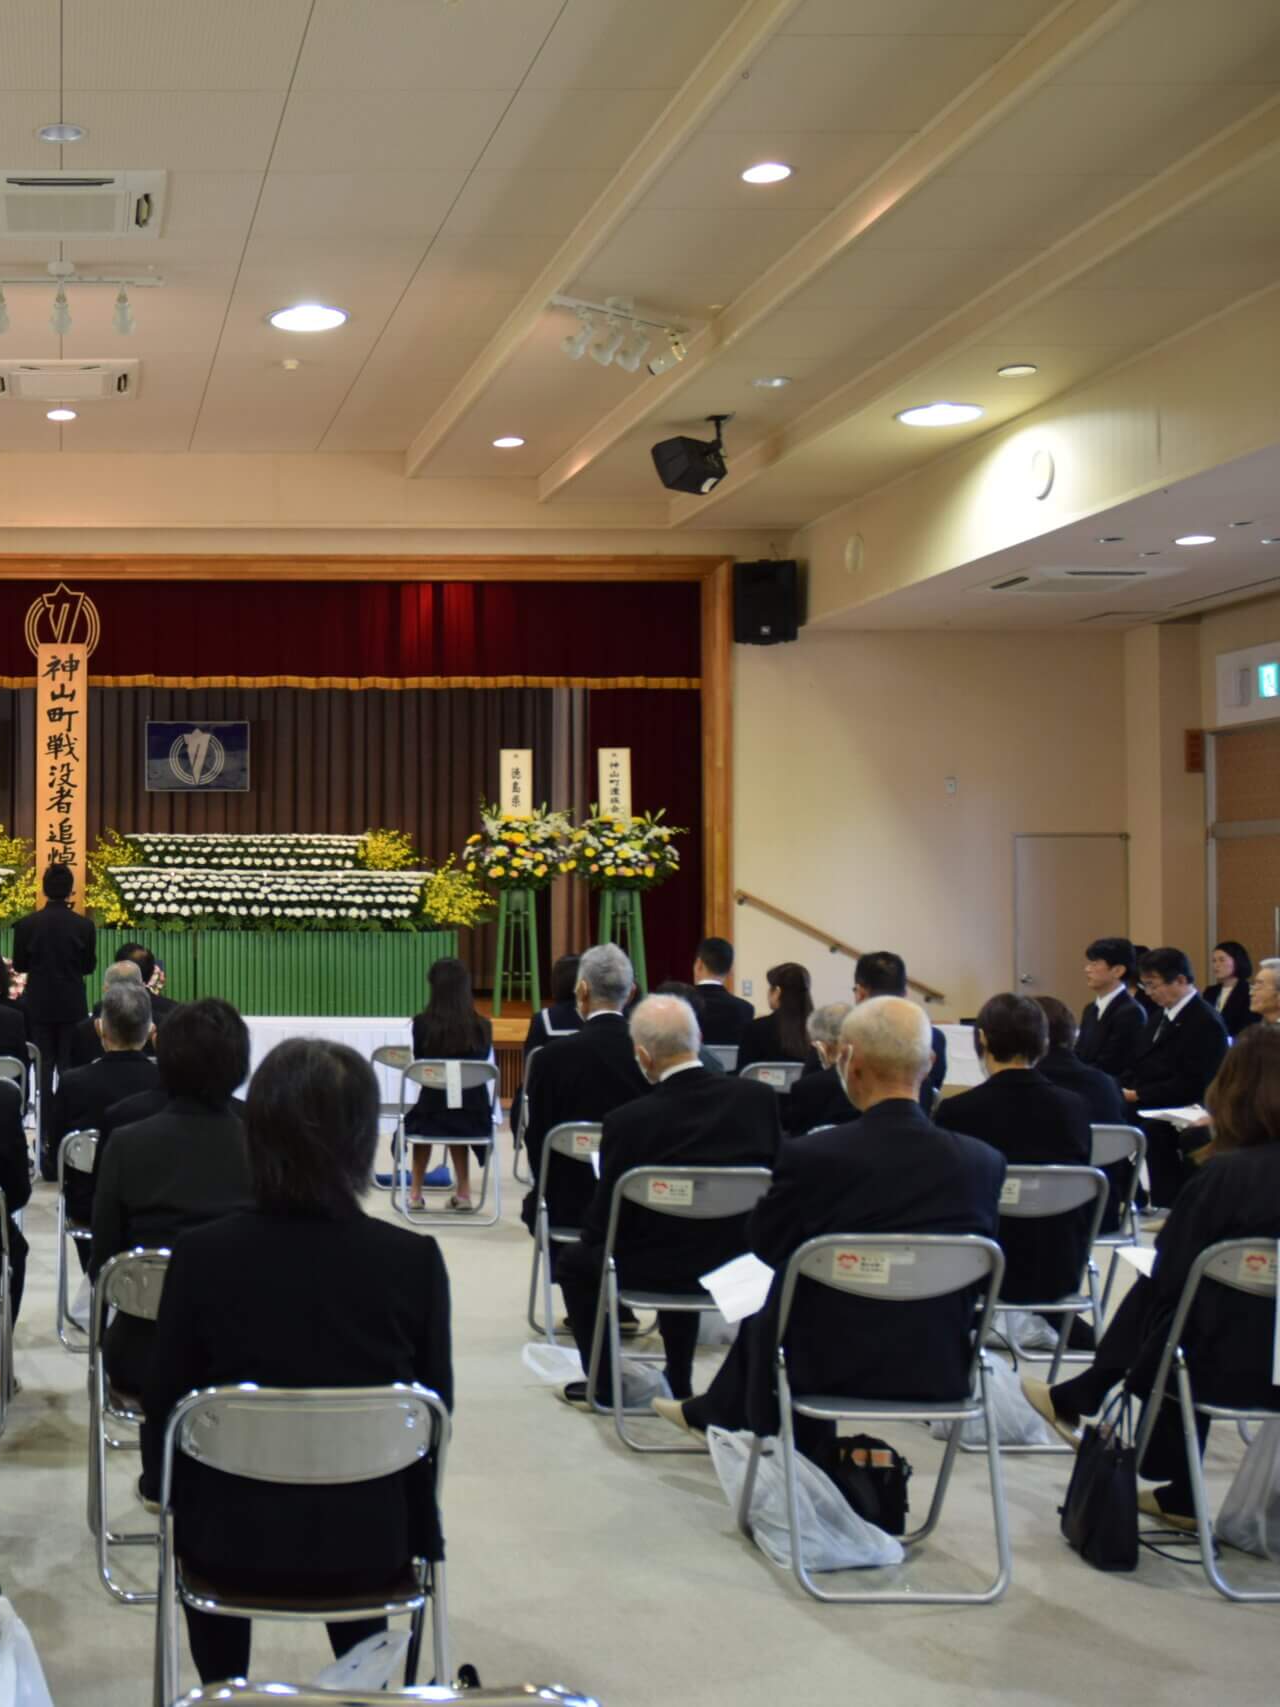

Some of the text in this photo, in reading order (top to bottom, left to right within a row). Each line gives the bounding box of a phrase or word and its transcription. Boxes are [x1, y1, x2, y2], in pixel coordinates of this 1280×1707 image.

[41, 652, 81, 896] 神山町戦没者追悼
